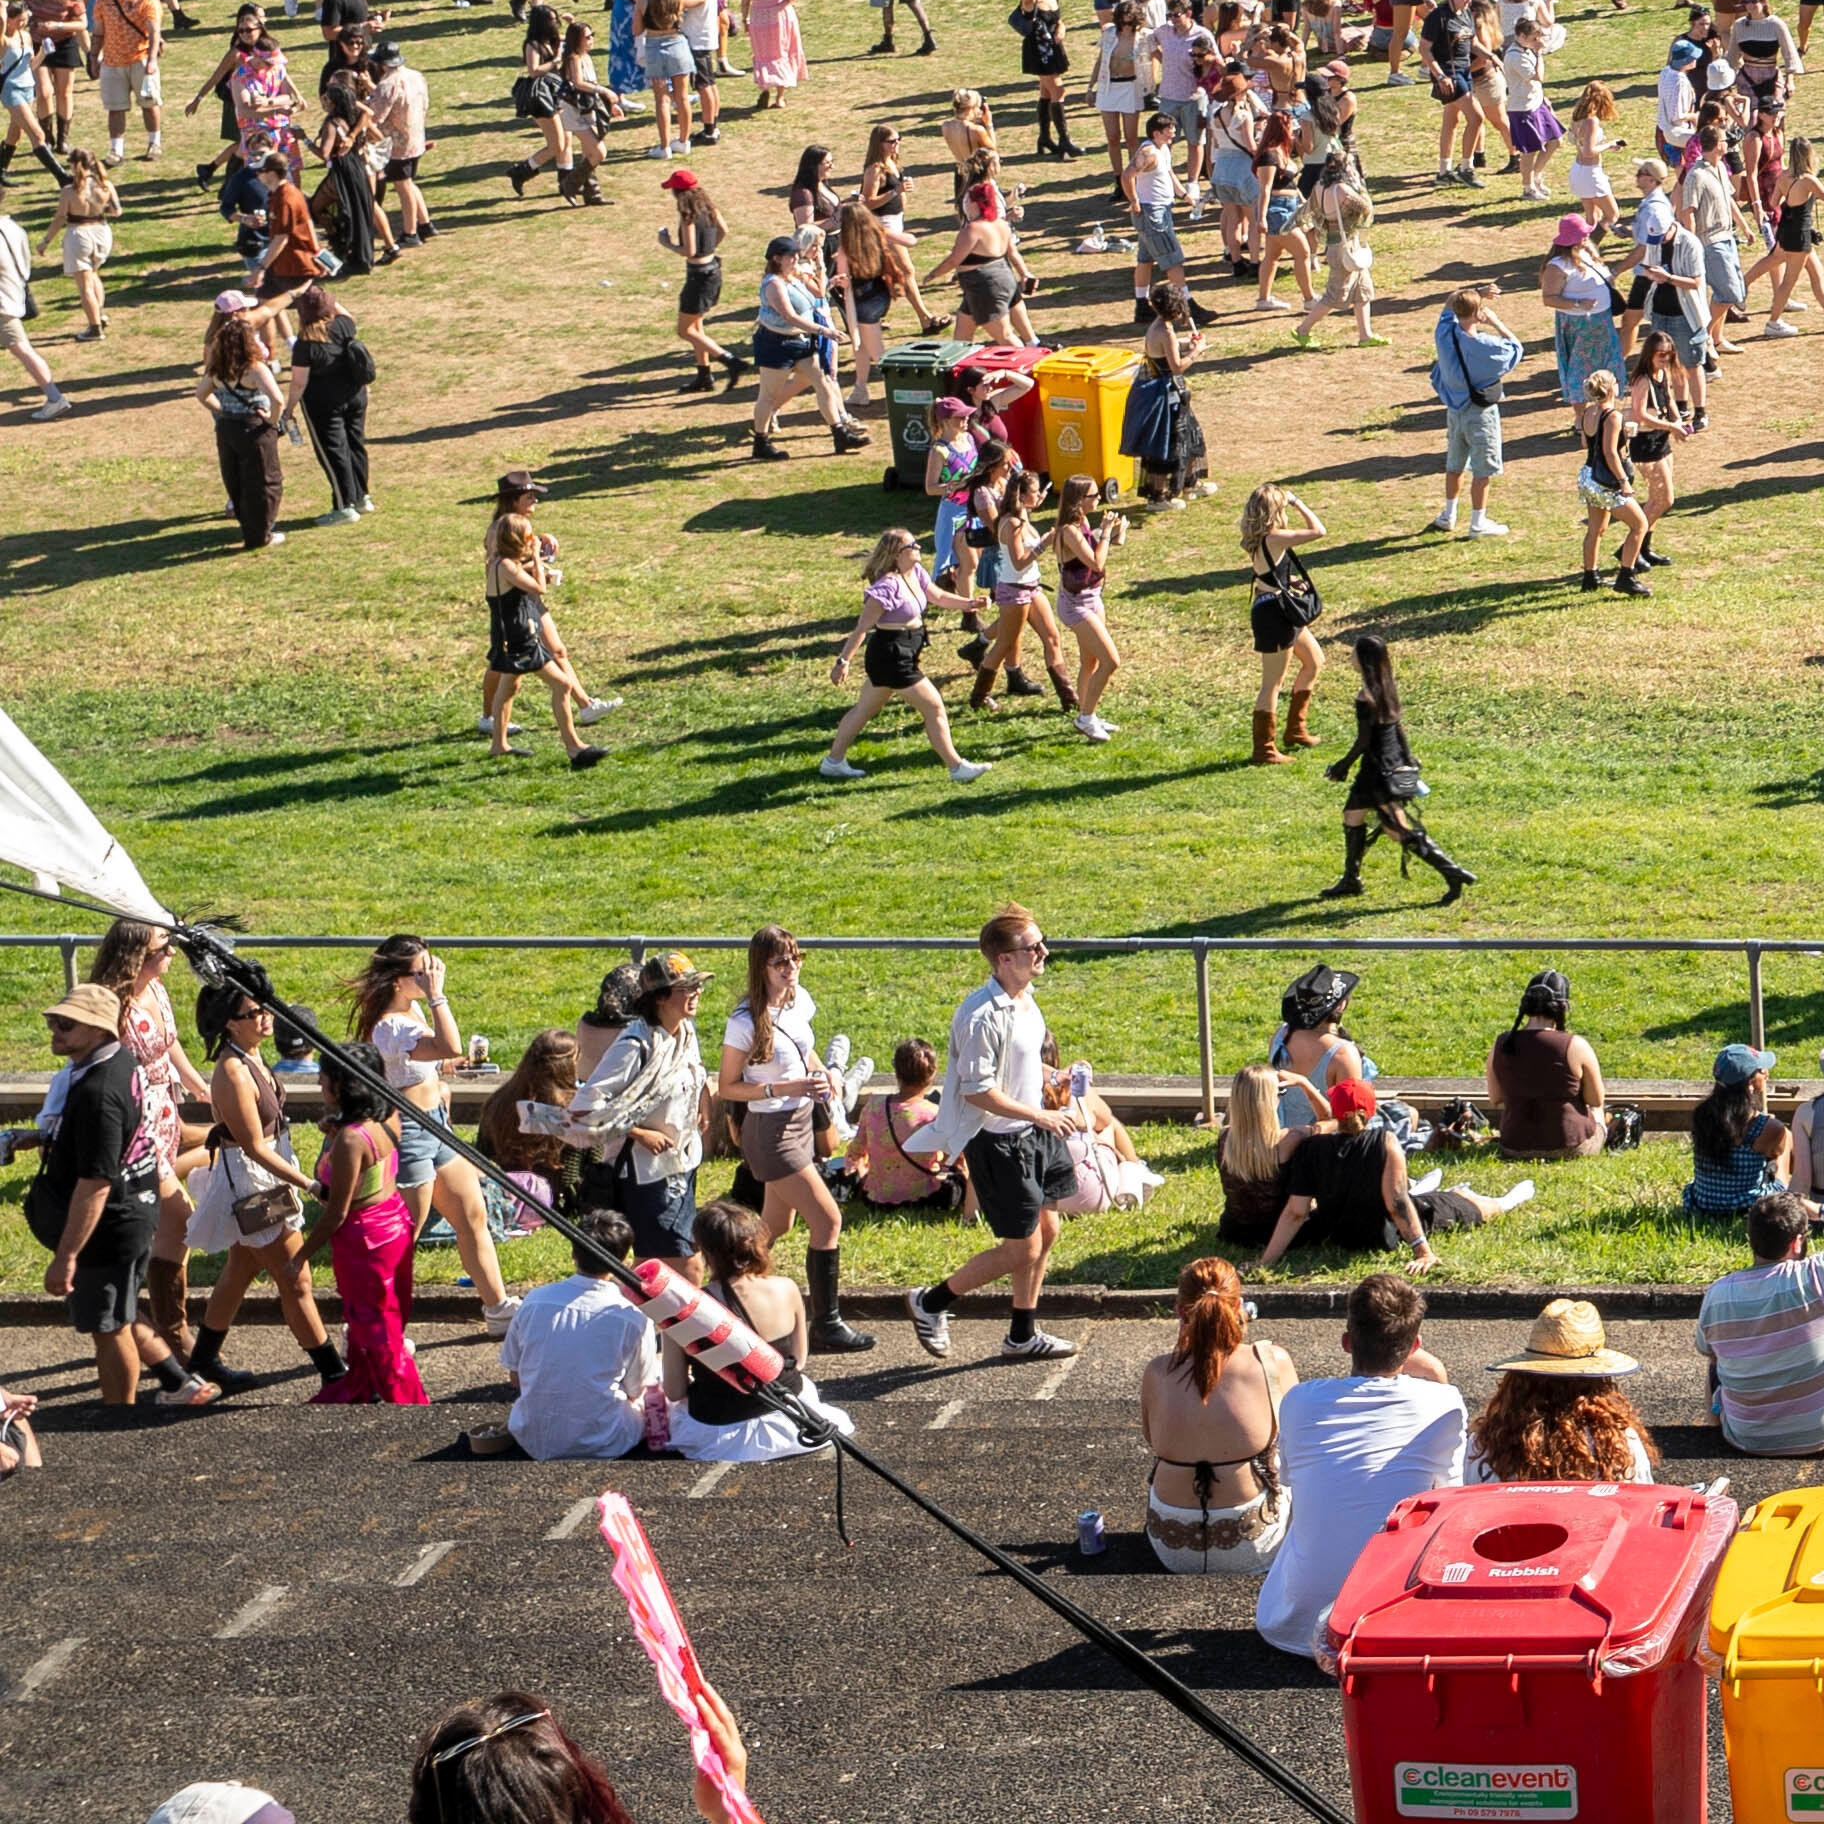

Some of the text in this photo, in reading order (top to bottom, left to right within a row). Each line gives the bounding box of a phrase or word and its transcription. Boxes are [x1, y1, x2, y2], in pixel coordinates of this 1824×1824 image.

[1488, 1566, 1559, 1577] Rubbish
[1423, 1766, 1568, 1789] cleanevent
[1453, 1808, 1466, 1816] Ph
[1468, 1808, 1479, 1816] 09
[1481, 1809, 1497, 1817] 579
